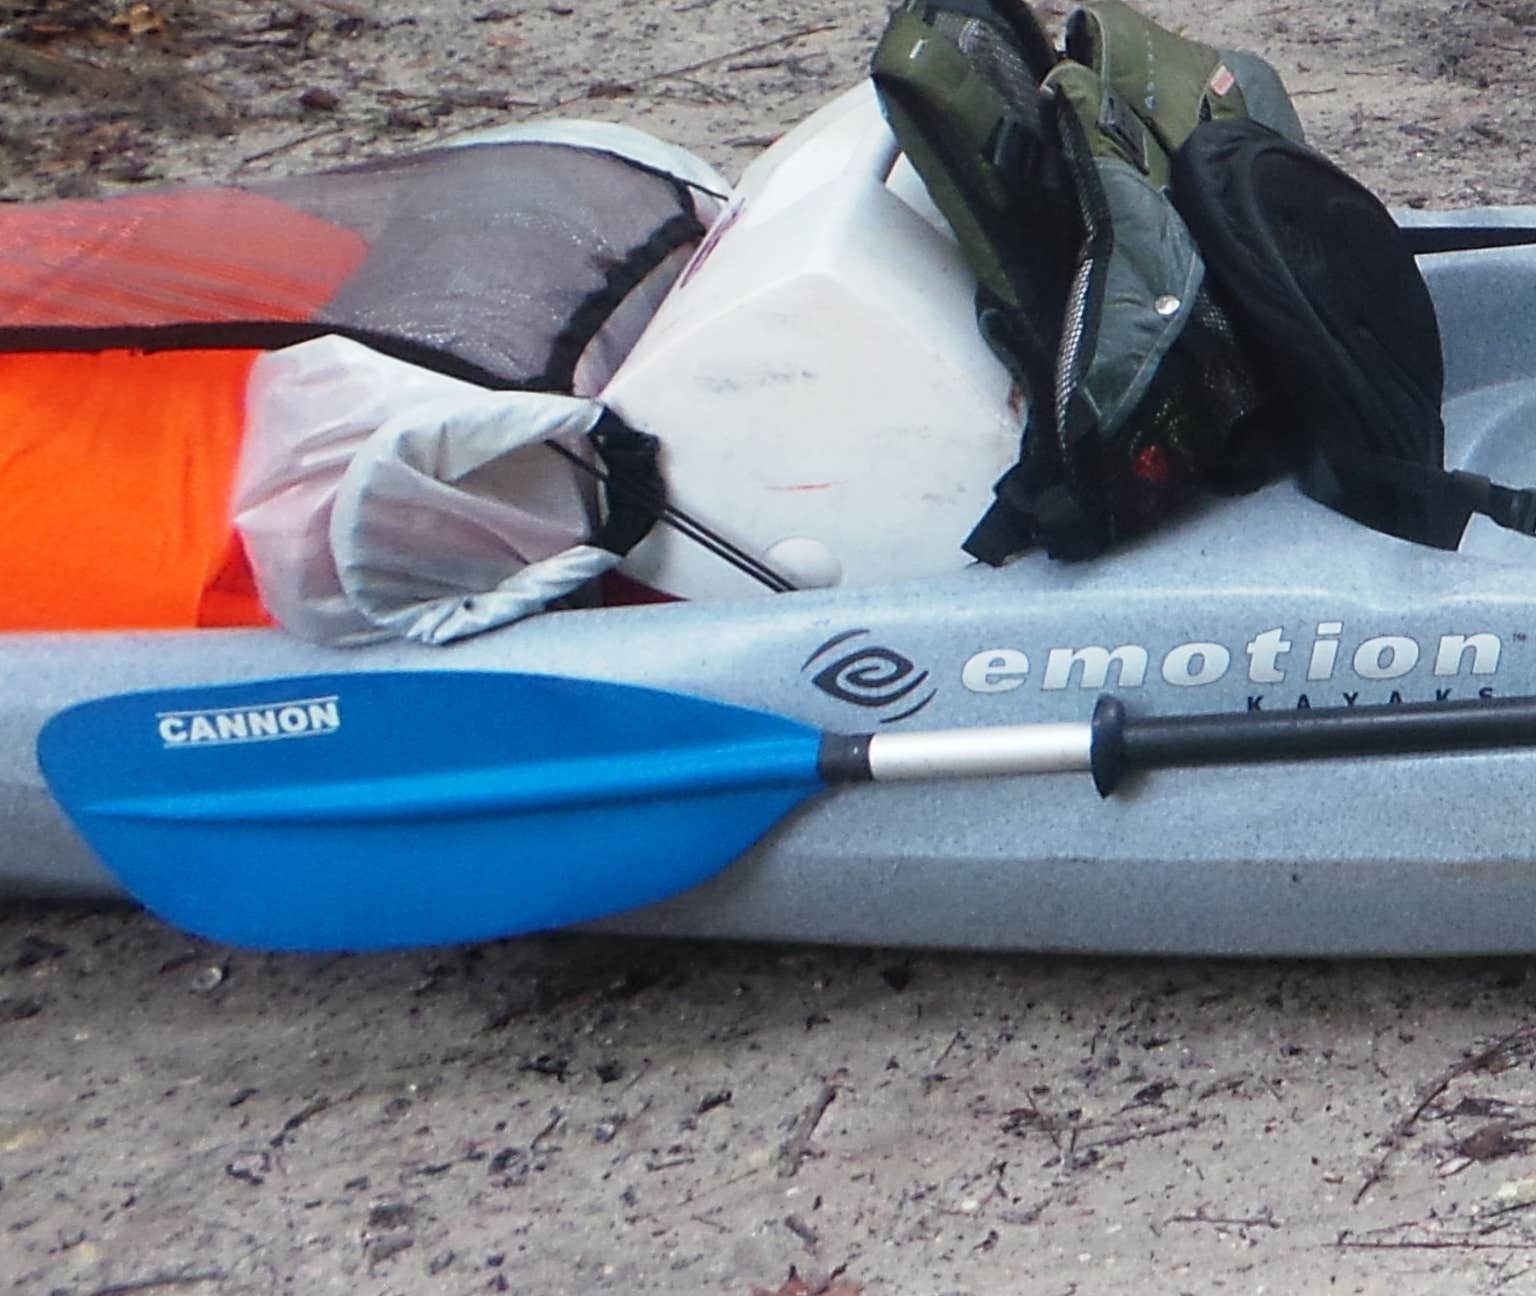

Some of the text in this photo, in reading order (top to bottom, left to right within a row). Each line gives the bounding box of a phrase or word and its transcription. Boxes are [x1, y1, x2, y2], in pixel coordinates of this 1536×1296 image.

[961, 620, 1502, 694] emotion
[1246, 687, 1494, 712] KAYAKS
[158, 702, 341, 743] CANNON
